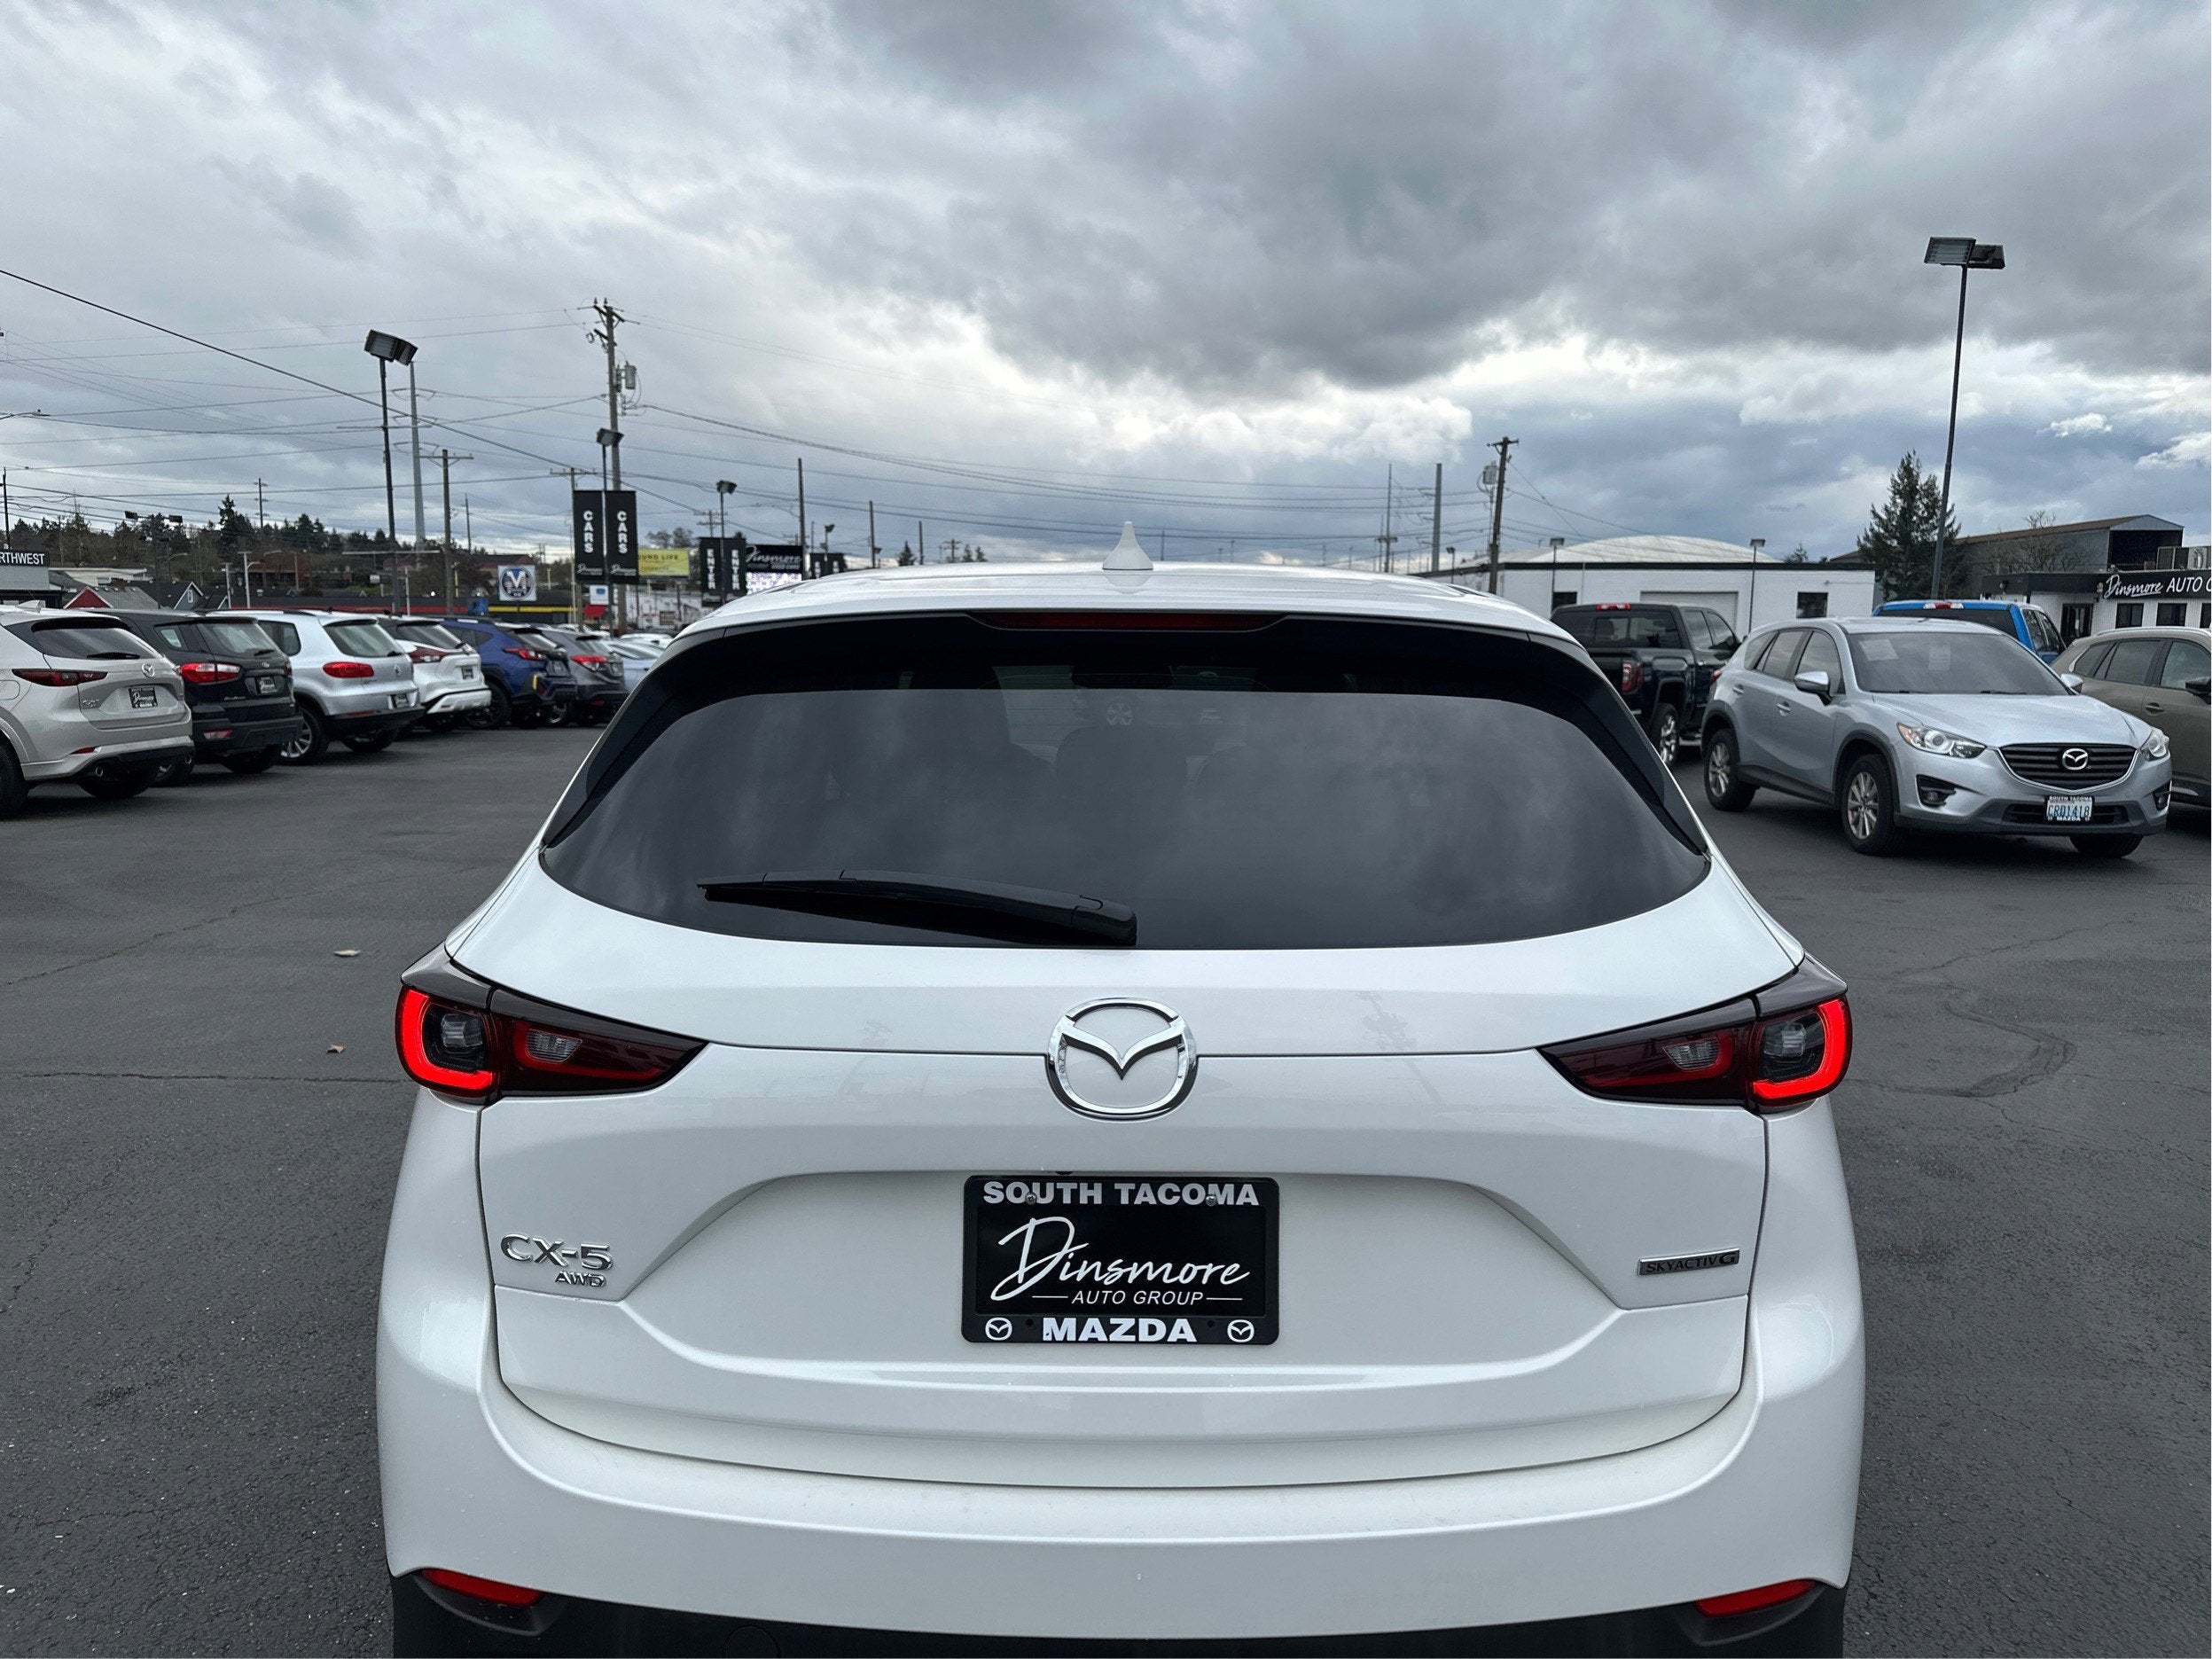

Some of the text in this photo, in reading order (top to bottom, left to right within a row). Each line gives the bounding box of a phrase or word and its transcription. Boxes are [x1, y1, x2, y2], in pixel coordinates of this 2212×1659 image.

[583, 510, 594, 553] CARS
[617, 510, 628, 554] CARS
[0, 552, 44, 565] RTHWEST
[707, 548, 716, 590] ENTER
[731, 549, 741, 591] ENTER
[2103, 574, 2164, 599] Dinsmore
[2166, 576, 2203, 593] AUTO
[983, 1181, 1260, 1206] SOUTH TACOMA
[500, 1233, 614, 1271] CX-5
[990, 1216, 1250, 1302] Dinsmore
[554, 1271, 606, 1287] AWD
[1072, 1290, 1204, 1306] AUTO GROUP
[1042, 1317, 1197, 1342] MAZDA
